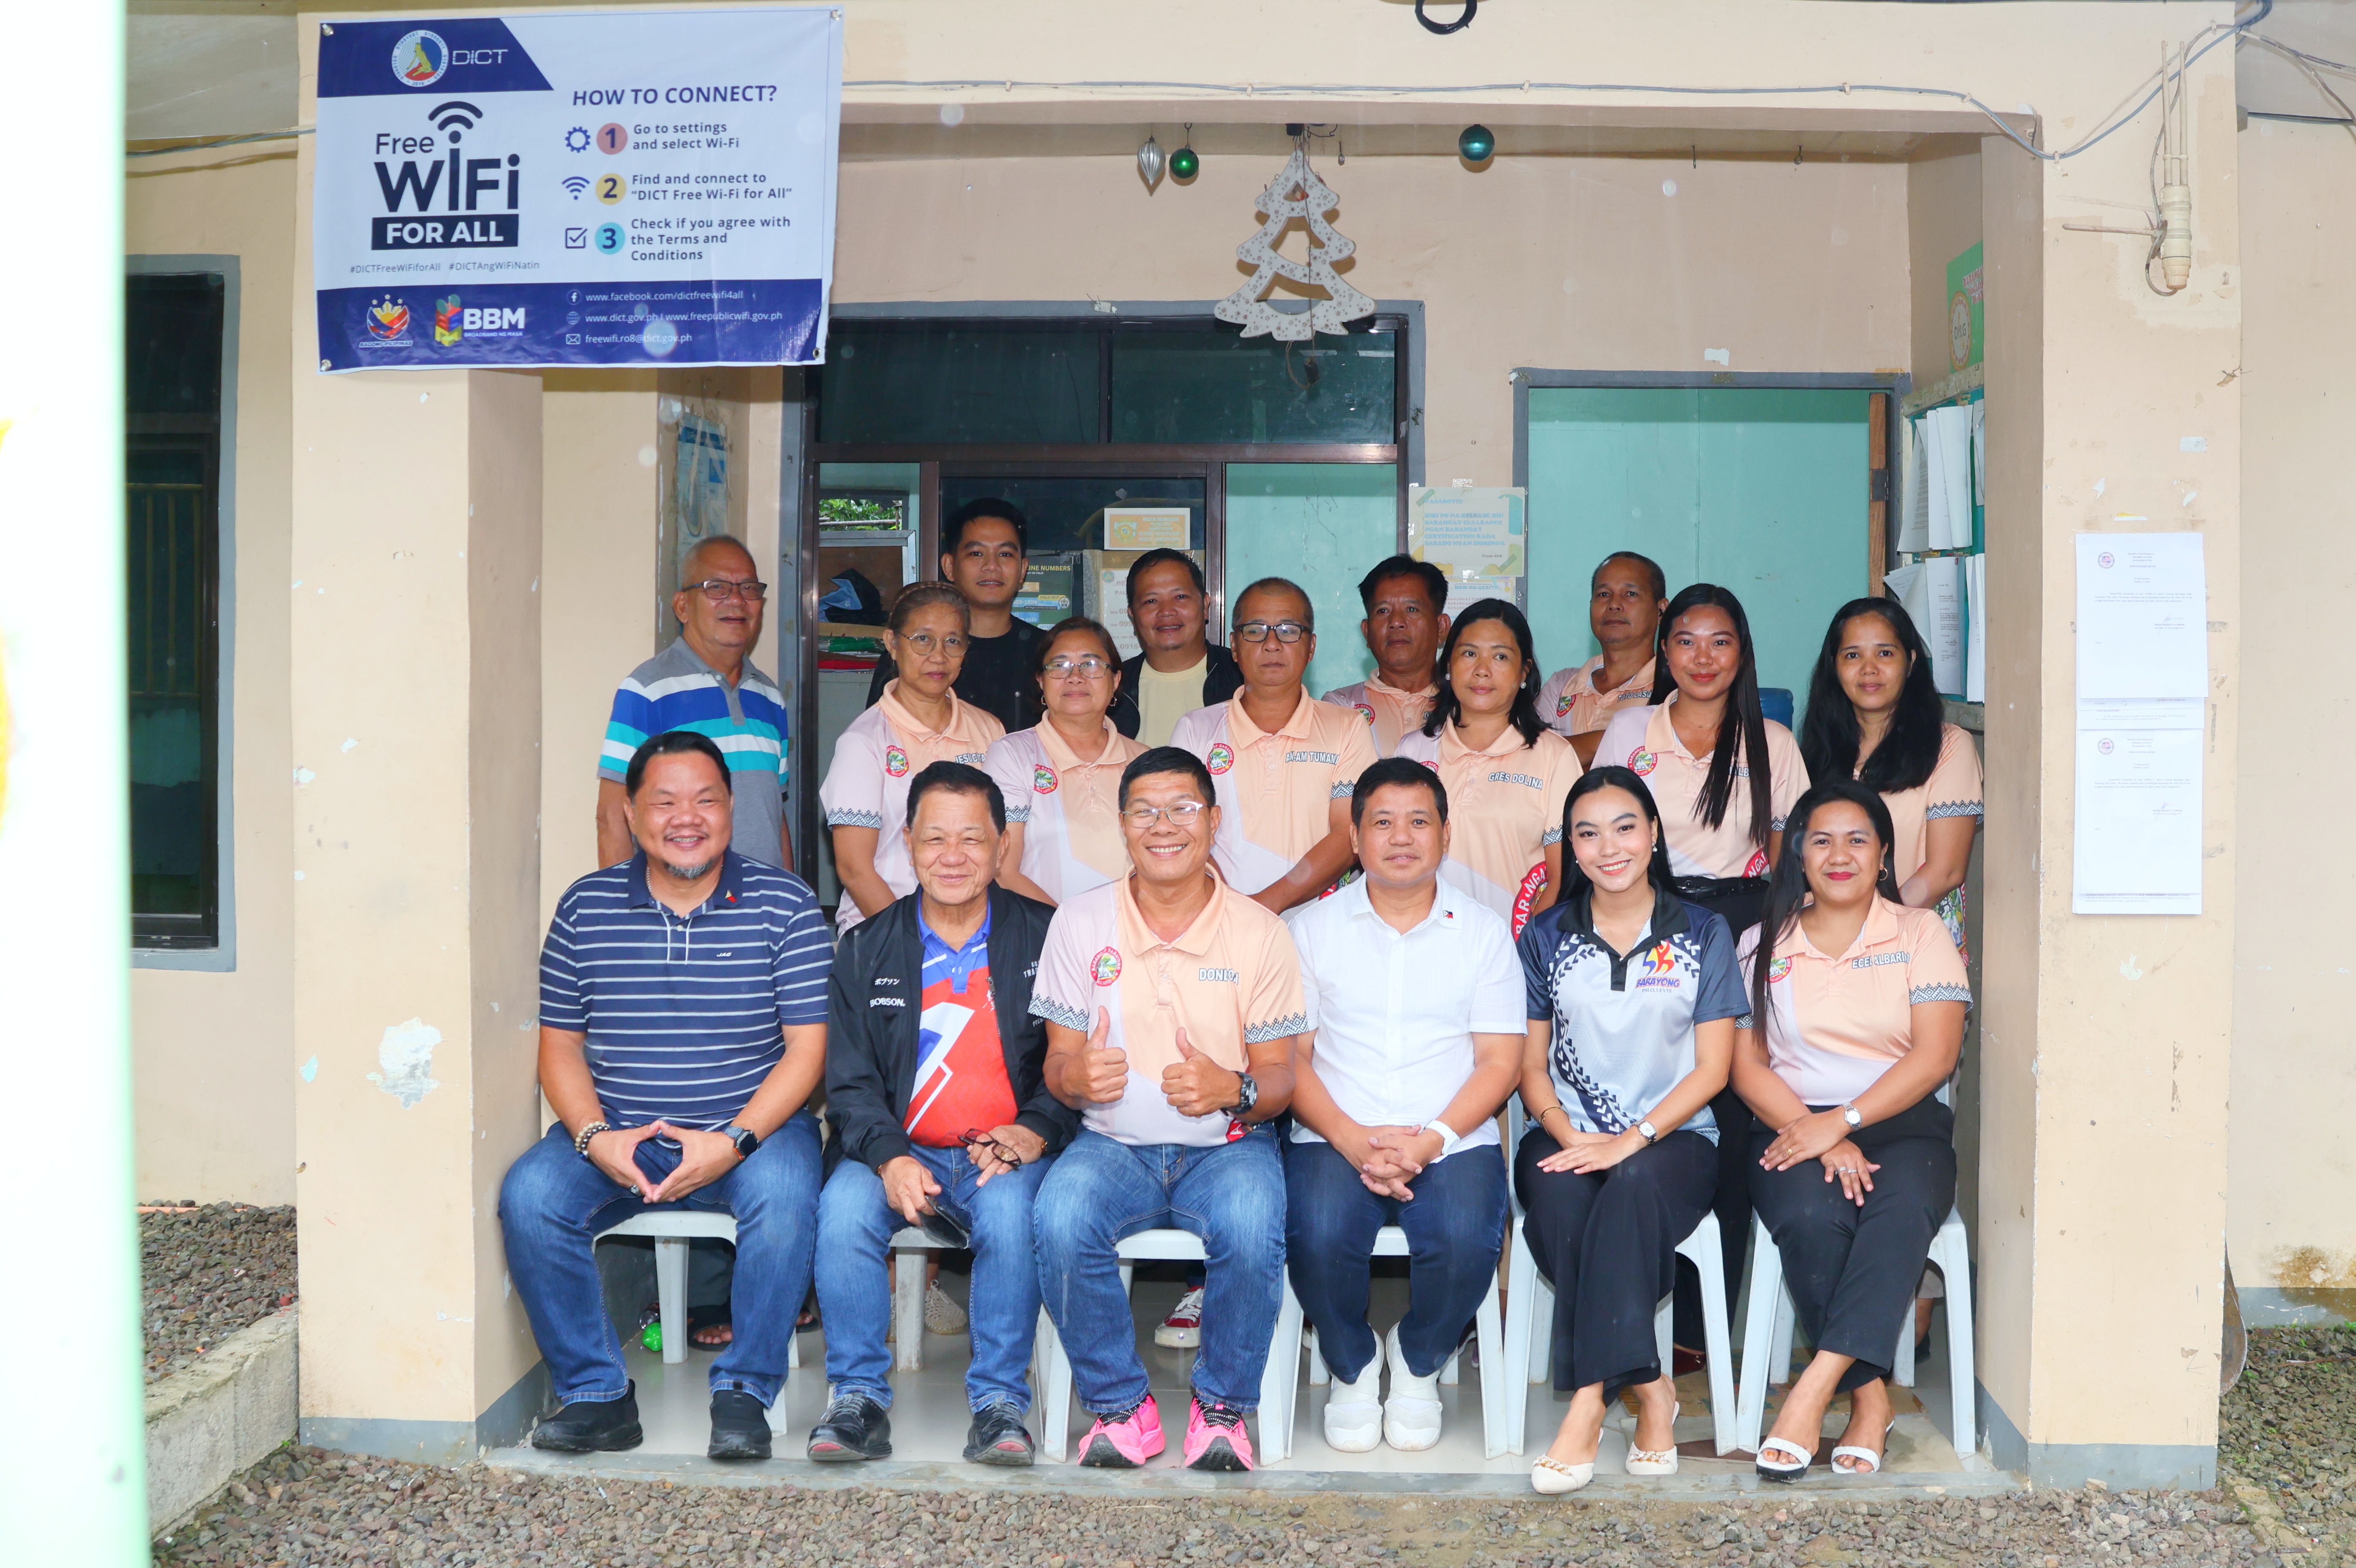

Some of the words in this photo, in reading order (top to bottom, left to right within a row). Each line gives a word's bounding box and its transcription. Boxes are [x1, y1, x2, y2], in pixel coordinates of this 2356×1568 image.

[452, 49, 509, 65] DICT
[573, 89, 624, 106] HOW
[631, 89, 658, 104] TO
[665, 85, 777, 103] CONNECT?
[634, 125, 650, 134] Go
[655, 124, 668, 133] to
[673, 122, 727, 135] settings
[375, 132, 435, 155] Free
[605, 127, 616, 149] 1
[633, 139, 657, 150] and
[662, 139, 701, 149] select
[706, 138, 739, 148] Wi-Fi
[633, 174, 660, 185] Find
[665, 174, 690, 184] and
[695, 173, 748, 184] connect
[753, 173, 766, 183] to
[603, 177, 617, 199] 2
[674, 189, 702, 200] Free
[706, 188, 739, 199] Wi-Fi
[744, 188, 763, 199] for
[631, 218, 671, 229] Check
[676, 218, 686, 229] if
[690, 218, 713, 231] you
[718, 219, 755, 230] agree
[760, 216, 790, 227] with
[386, 222, 445, 245] FOR
[450, 220, 504, 243] ALL
[602, 227, 616, 250] 3
[631, 234, 653, 245] the
[658, 234, 699, 245] Terms
[704, 233, 727, 244] and
[631, 250, 703, 261] Conditions
[350, 263, 441, 274] #DICTFreeWiFiforAll
[448, 261, 540, 272] #DICTAngWiFiNatin
[585, 290, 744, 302] www.facebook.com/dictfreewifi4all
[464, 308, 525, 330] BBM
[585, 313, 657, 323] www.dict.gov.ph
[665, 311, 783, 322] www.freepublicwifi.gov.ph
[585, 333, 693, 344] freewifi.ro8@dict.gov.ph
[1954, 322, 1966, 340] DILG
[1617, 692, 1634, 702] TOTO
[1219, 744, 1233, 761] BARAYONG
[1628, 746, 1644, 764] BARANGAY
[1488, 772, 1511, 782] GRES
[1511, 774, 1543, 790] DOLINA
[1636, 977, 1680, 988] BARAYONG
